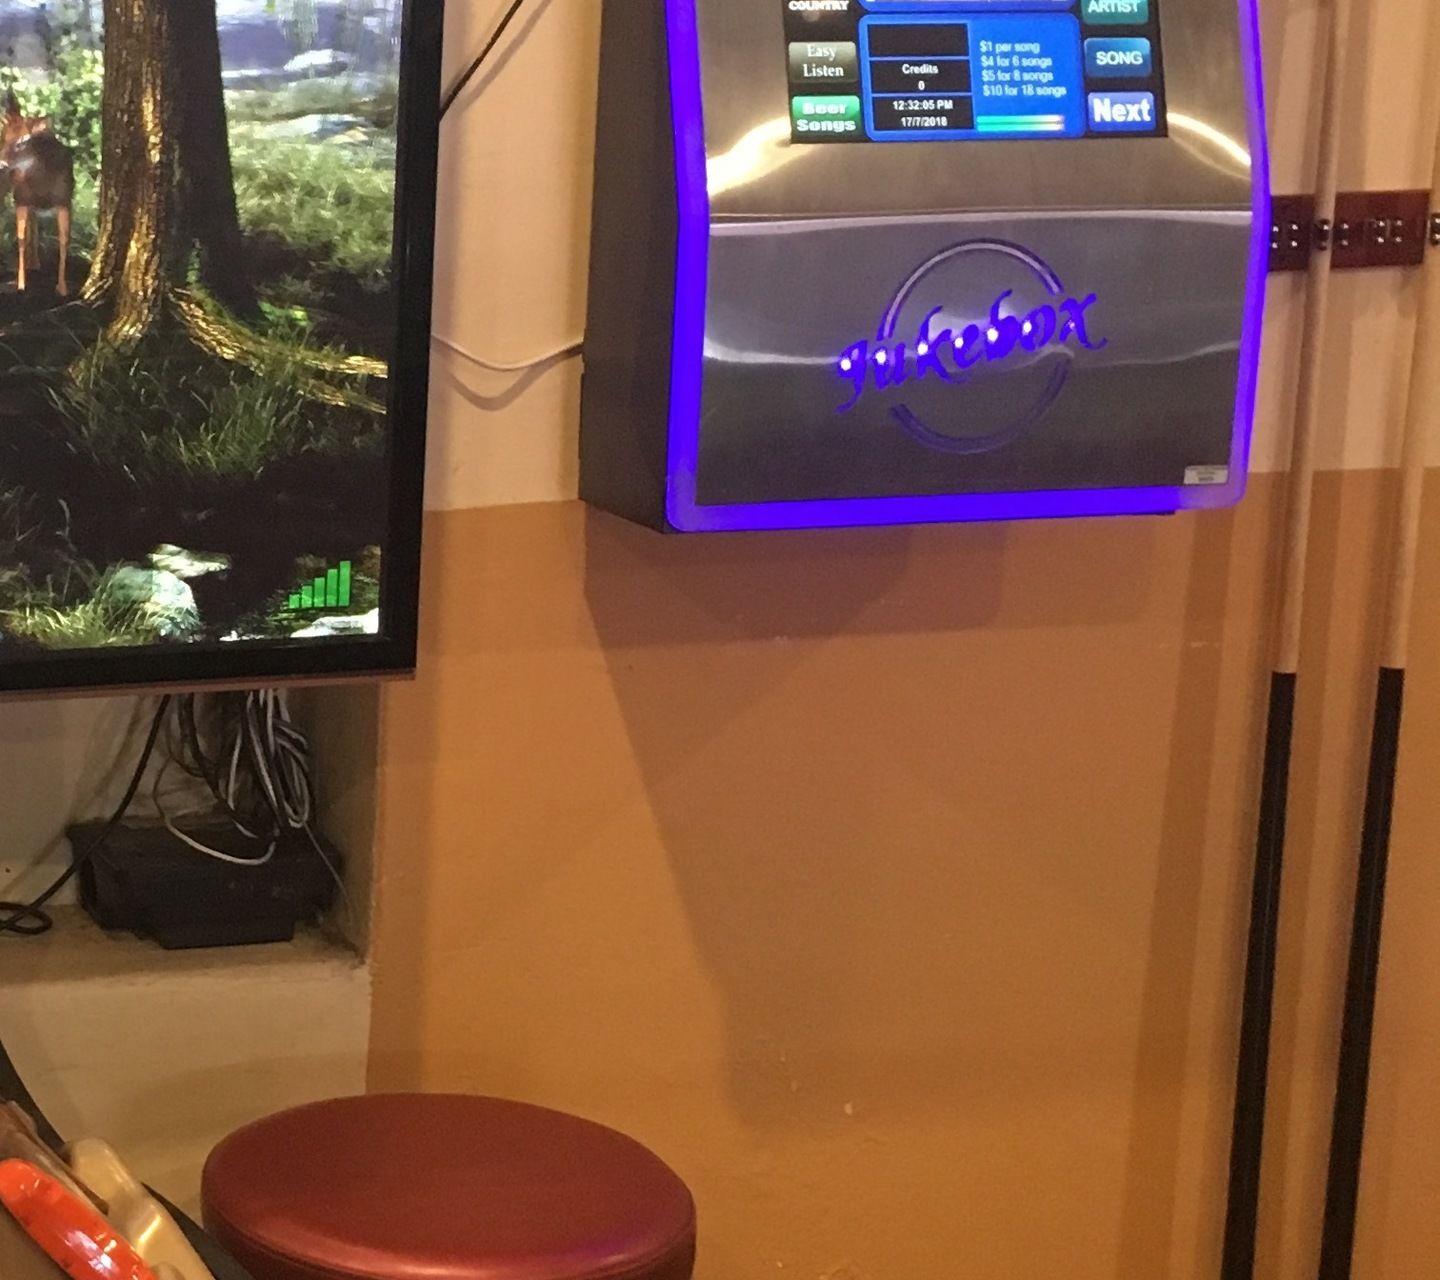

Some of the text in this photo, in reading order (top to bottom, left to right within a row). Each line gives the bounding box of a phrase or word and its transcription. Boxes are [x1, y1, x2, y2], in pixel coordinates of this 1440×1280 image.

[788, 0, 850, 11] COUNTRY
[1088, 0, 1140, 13] ARTIST
[807, 43, 837, 61] Easy
[980, 40, 992, 52] $1
[1014, 43, 1040, 54] song
[996, 55, 1010, 66] for
[1021, 57, 1052, 69] songs
[1096, 51, 1143, 65] SONG
[803, 63, 844, 77] Listen
[902, 63, 939, 74] Credits
[997, 69, 1011, 81] for
[1022, 71, 1054, 83] songs
[918, 80, 925, 90] 0
[983, 84, 1003, 96] $10
[1004, 84, 1018, 96] for
[1035, 86, 1067, 98] songs
[937, 100, 953, 110] PM
[1092, 98, 1152, 122] Next
[796, 119, 857, 132] Songs
